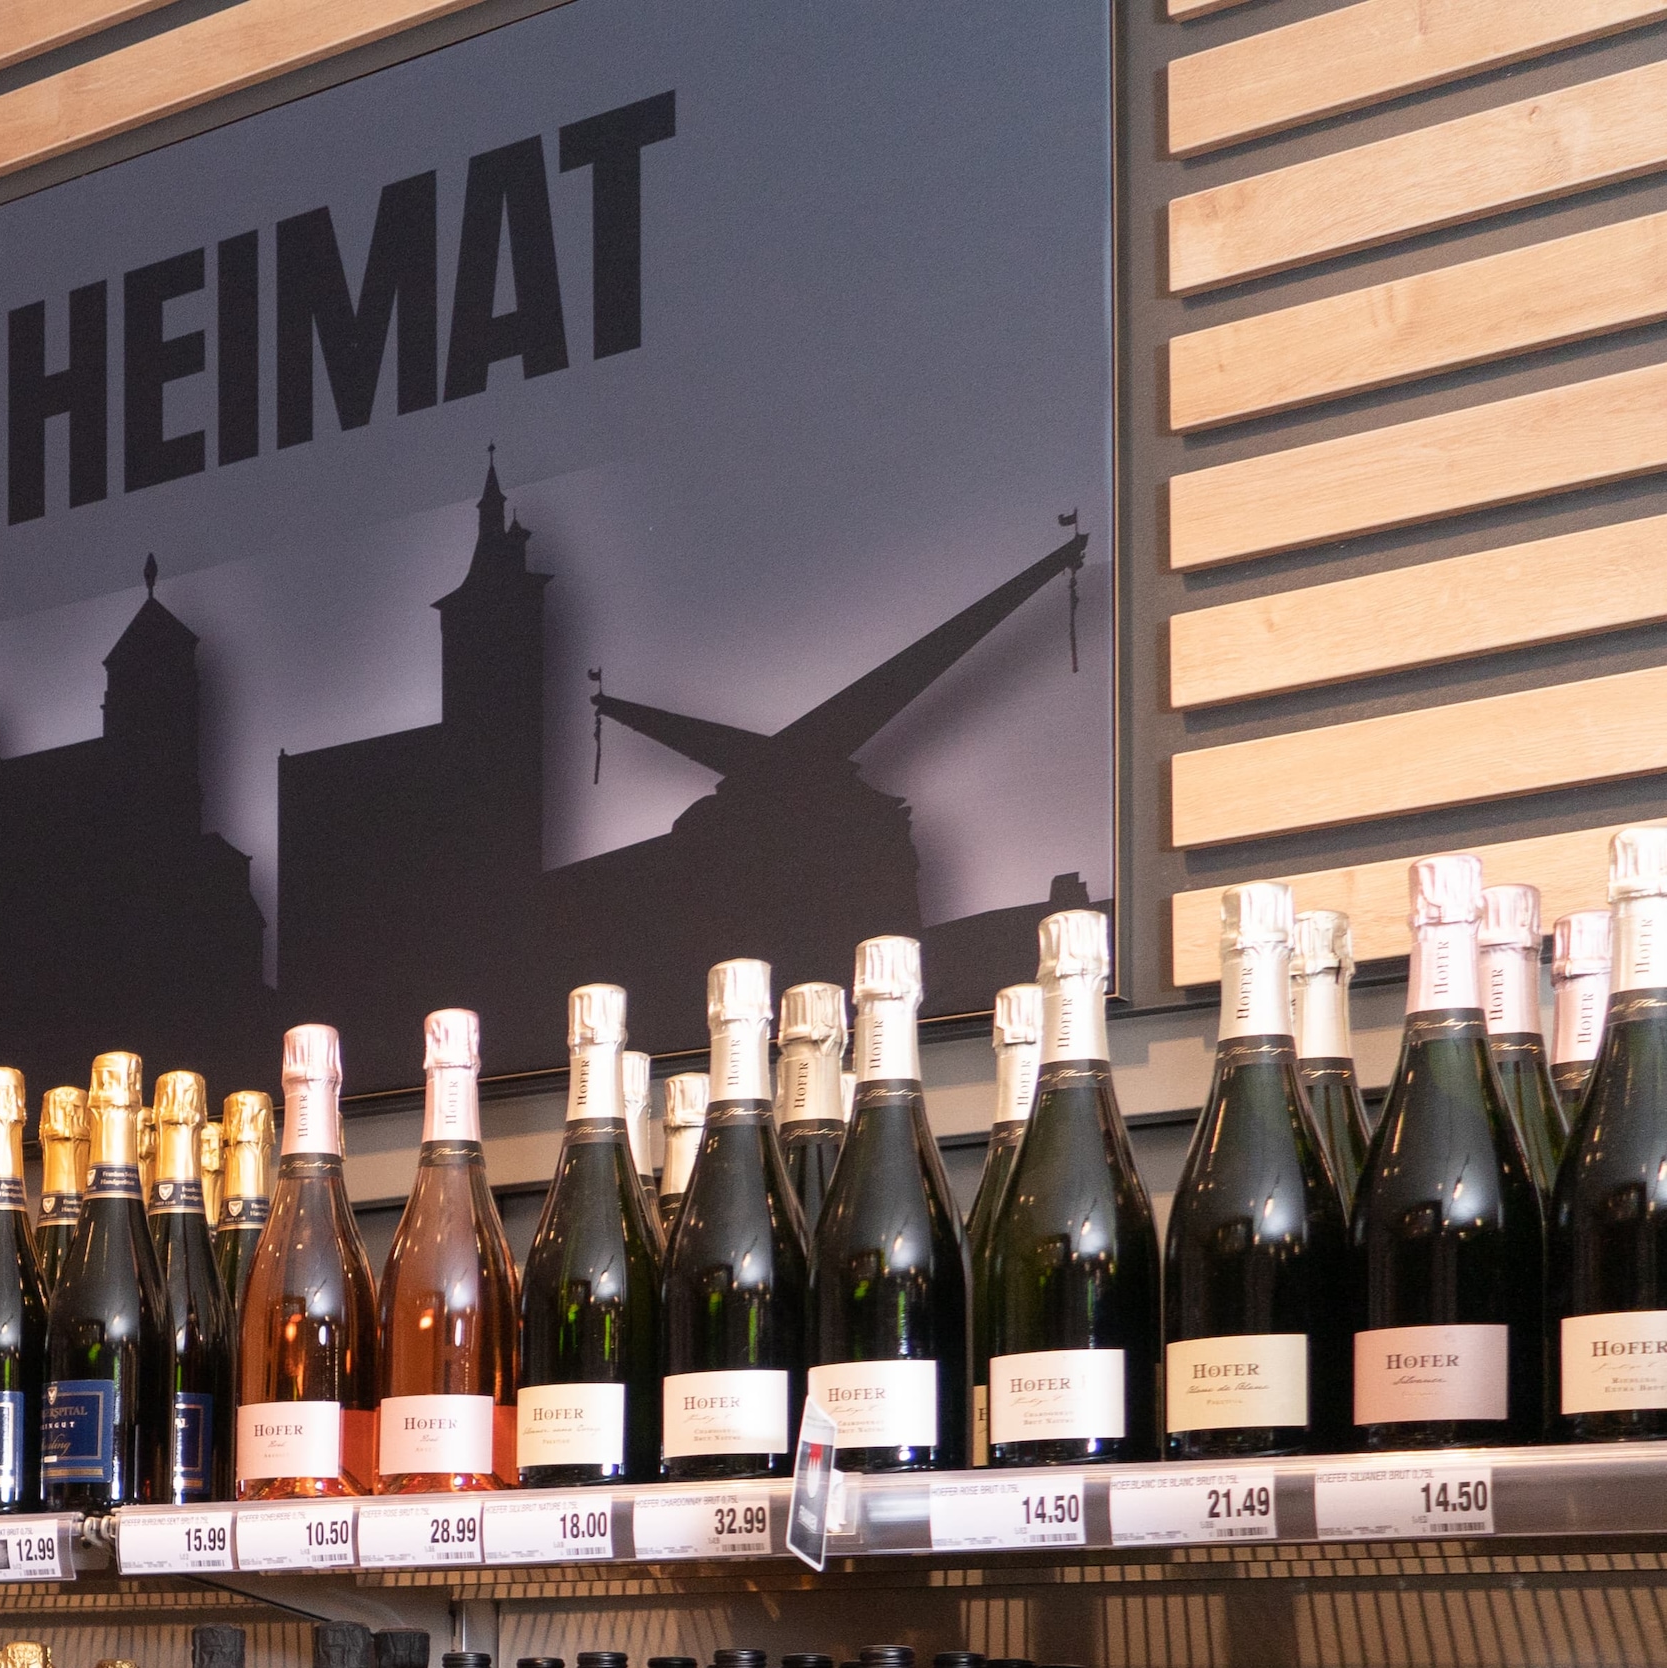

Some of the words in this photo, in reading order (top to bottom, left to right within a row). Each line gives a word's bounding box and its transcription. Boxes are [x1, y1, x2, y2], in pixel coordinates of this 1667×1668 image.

[6, 90, 677, 527] HEIMAT
[1022, 1494, 1079, 1524] 14.50
[1207, 1487, 1270, 1518] 21.49
[1421, 1480, 1487, 1513] 14.50
[306, 1520, 349, 1546] 10.50
[431, 1518, 476, 1543] 28.99
[560, 1512, 607, 1539] 18.00
[715, 1507, 766, 1535] 32.99
[17, 1538, 55, 1561] 12.99
[186, 1527, 226, 1551] 15.99
